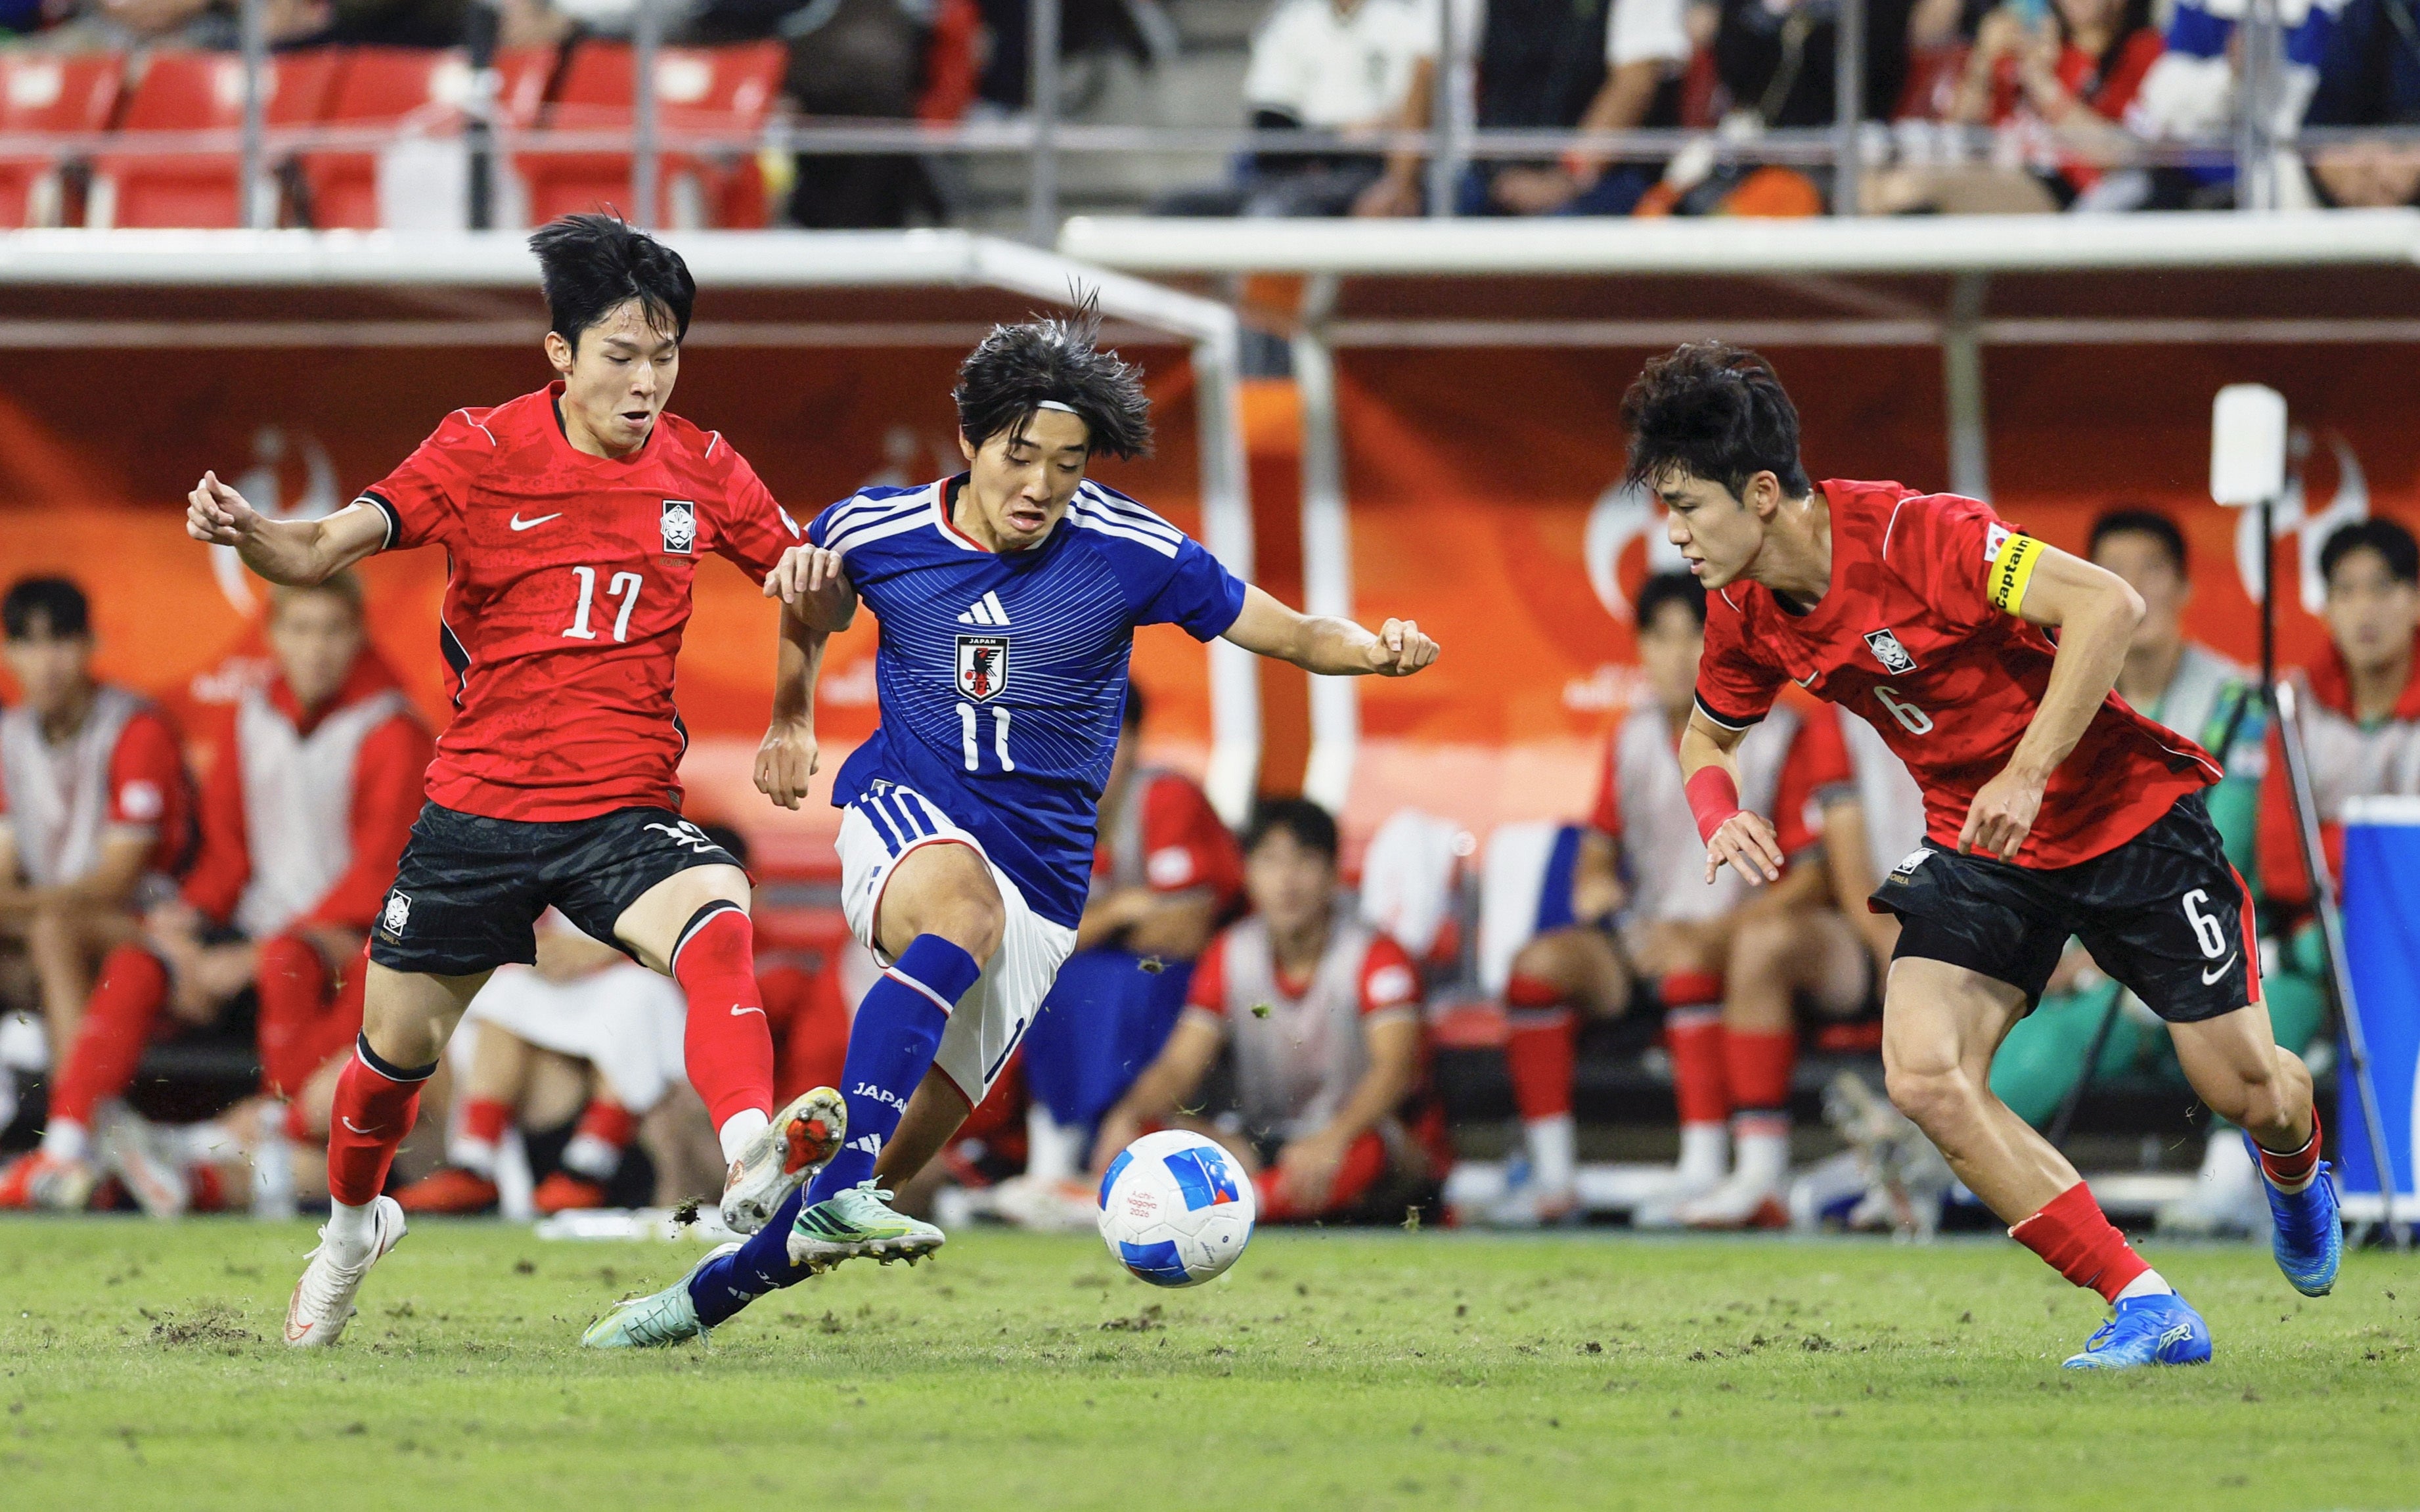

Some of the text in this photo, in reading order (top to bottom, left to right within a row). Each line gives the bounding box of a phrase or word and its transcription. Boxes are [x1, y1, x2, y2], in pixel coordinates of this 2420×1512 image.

[562, 566, 643, 643] 17
[1995, 539, 2030, 610] Captain
[969, 680, 992, 692] JFA
[1873, 686, 1934, 735] 6
[955, 701, 1015, 772] 11
[2182, 888, 2227, 959] 6
[1130, 1207, 1150, 1218] 2026
